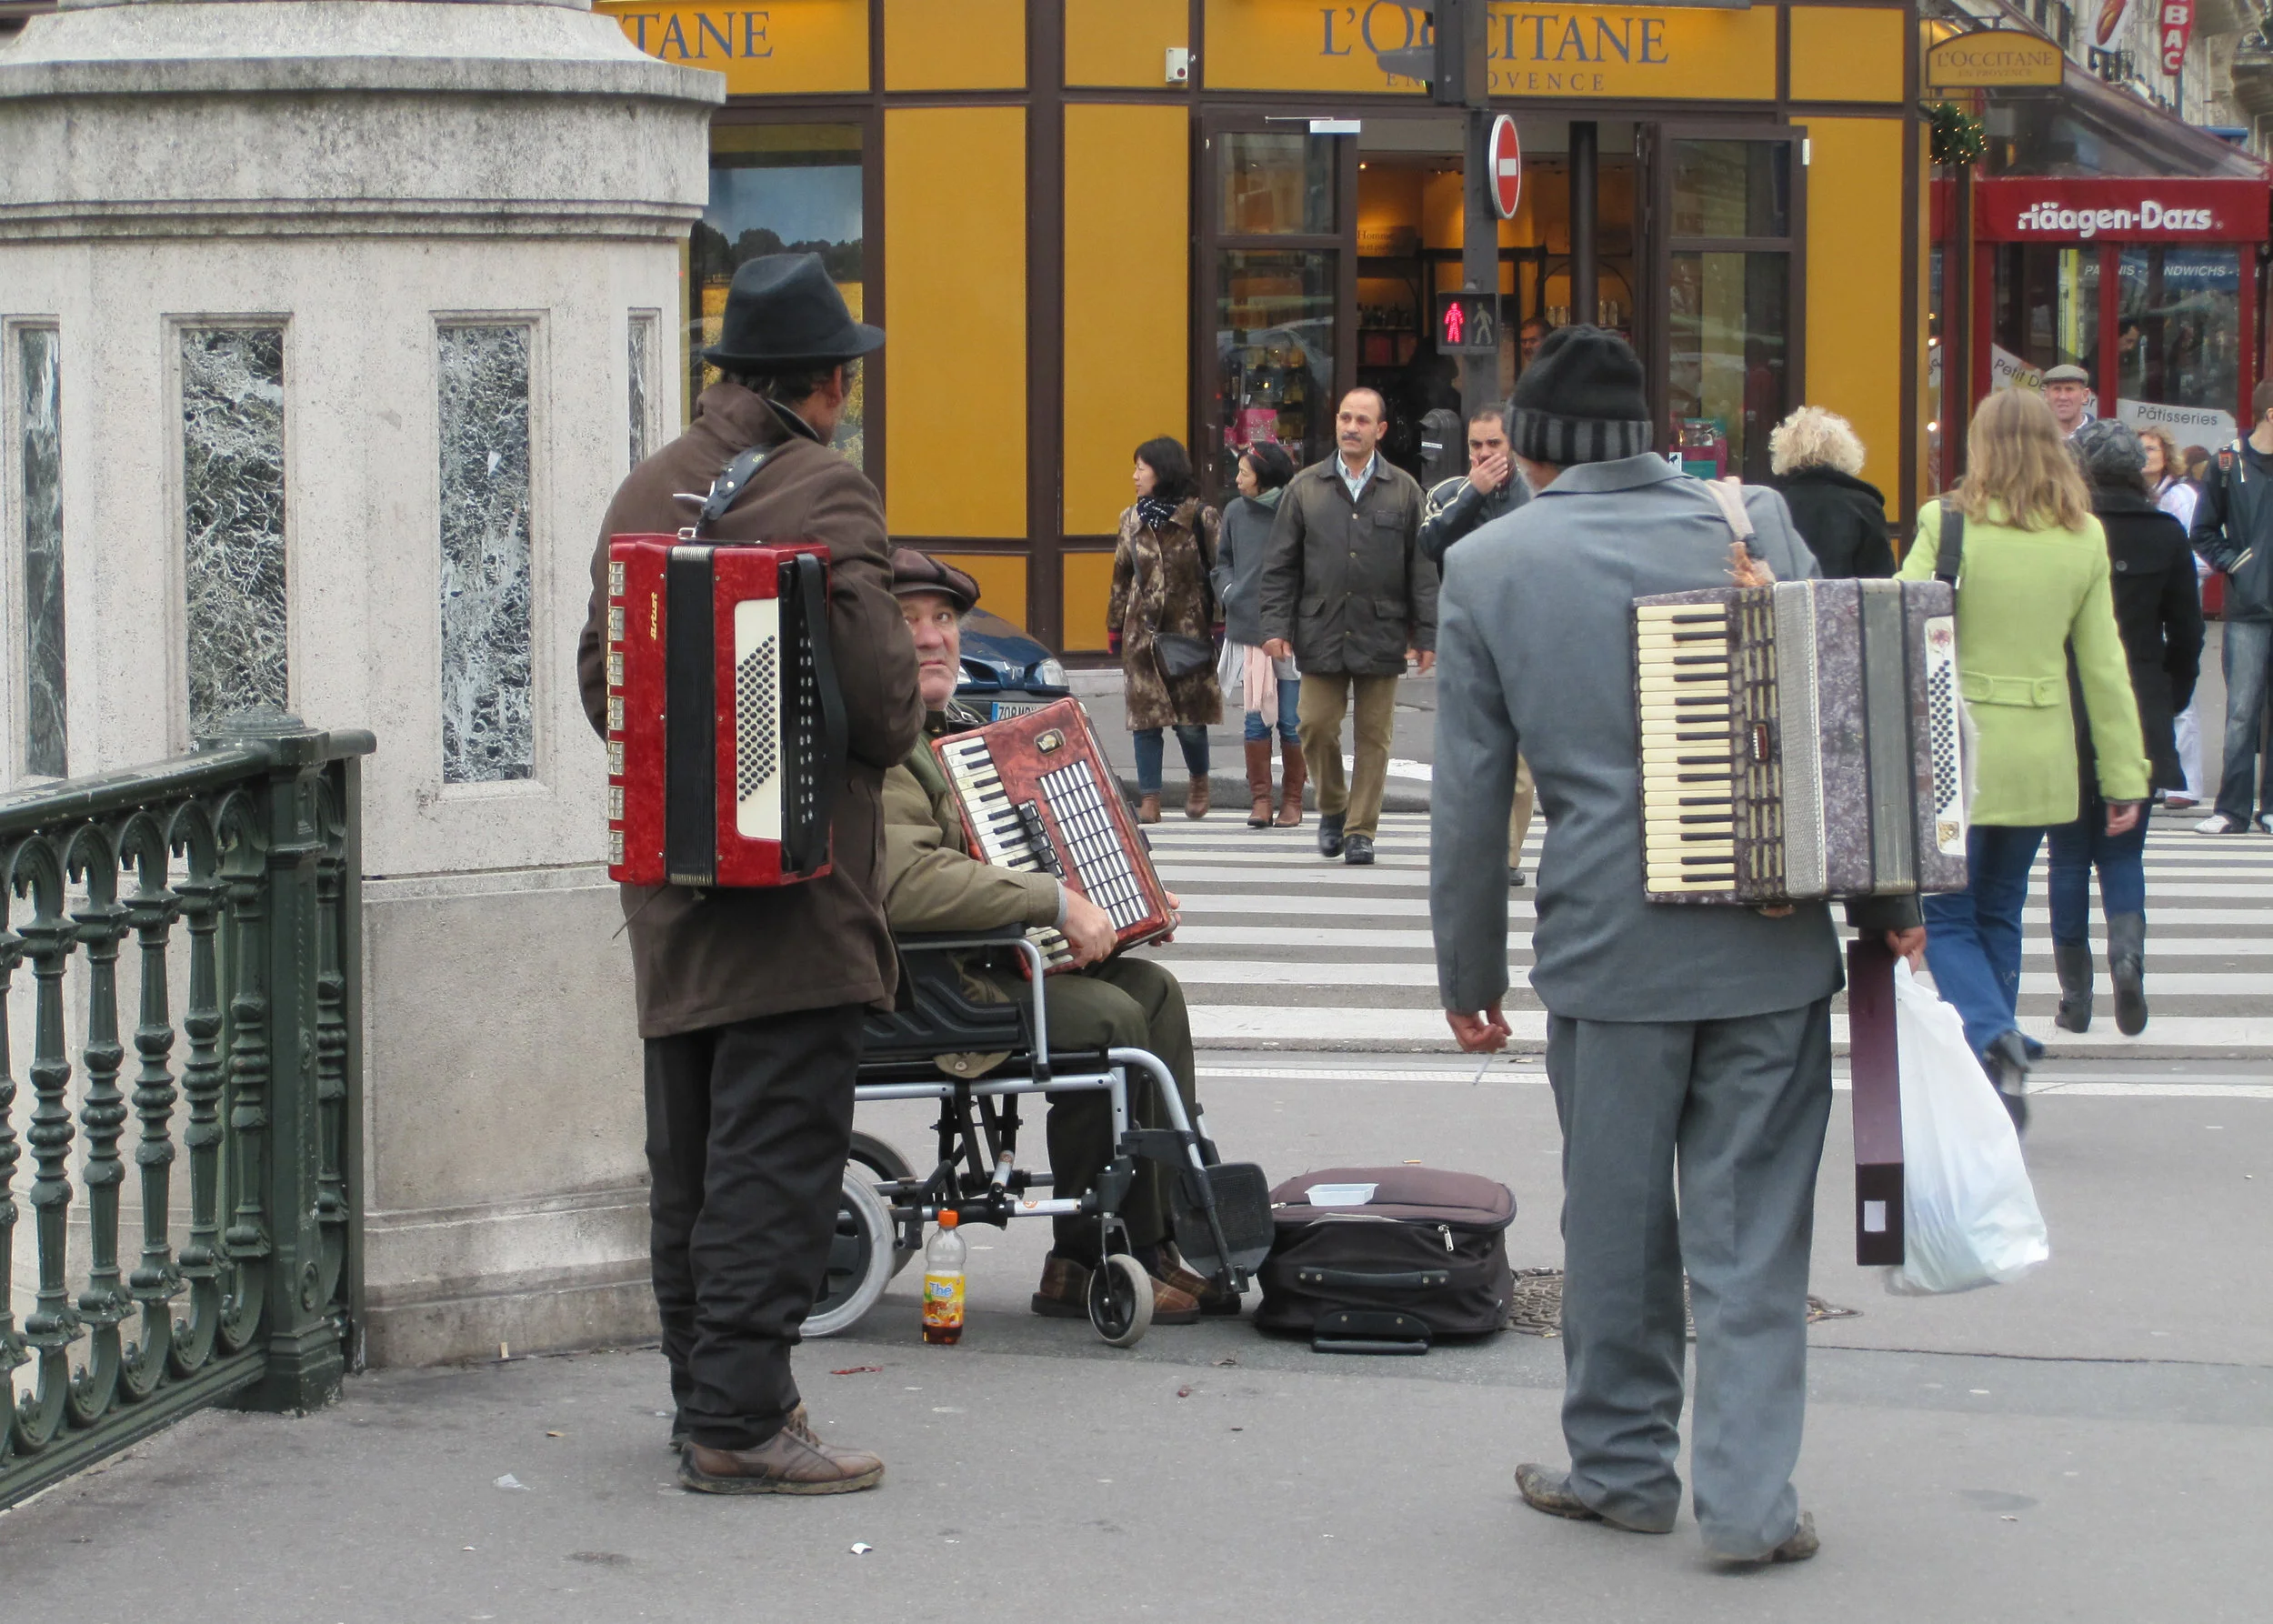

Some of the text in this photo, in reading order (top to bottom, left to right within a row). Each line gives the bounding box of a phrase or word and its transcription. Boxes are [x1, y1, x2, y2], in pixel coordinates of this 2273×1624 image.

[615, 11, 773, 59] TANE
[2164, 0, 2188, 70] BAC
[1937, 49, 2055, 68] L'OCCITANE
[1487, 72, 1605, 92] OVENCE
[1976, 68, 2033, 78] PROVENCE
[2018, 199, 2213, 239] Häagen-Dazs
[1993, 357, 2026, 383] Petit
[2136, 405, 2218, 426] Pâtisseries
